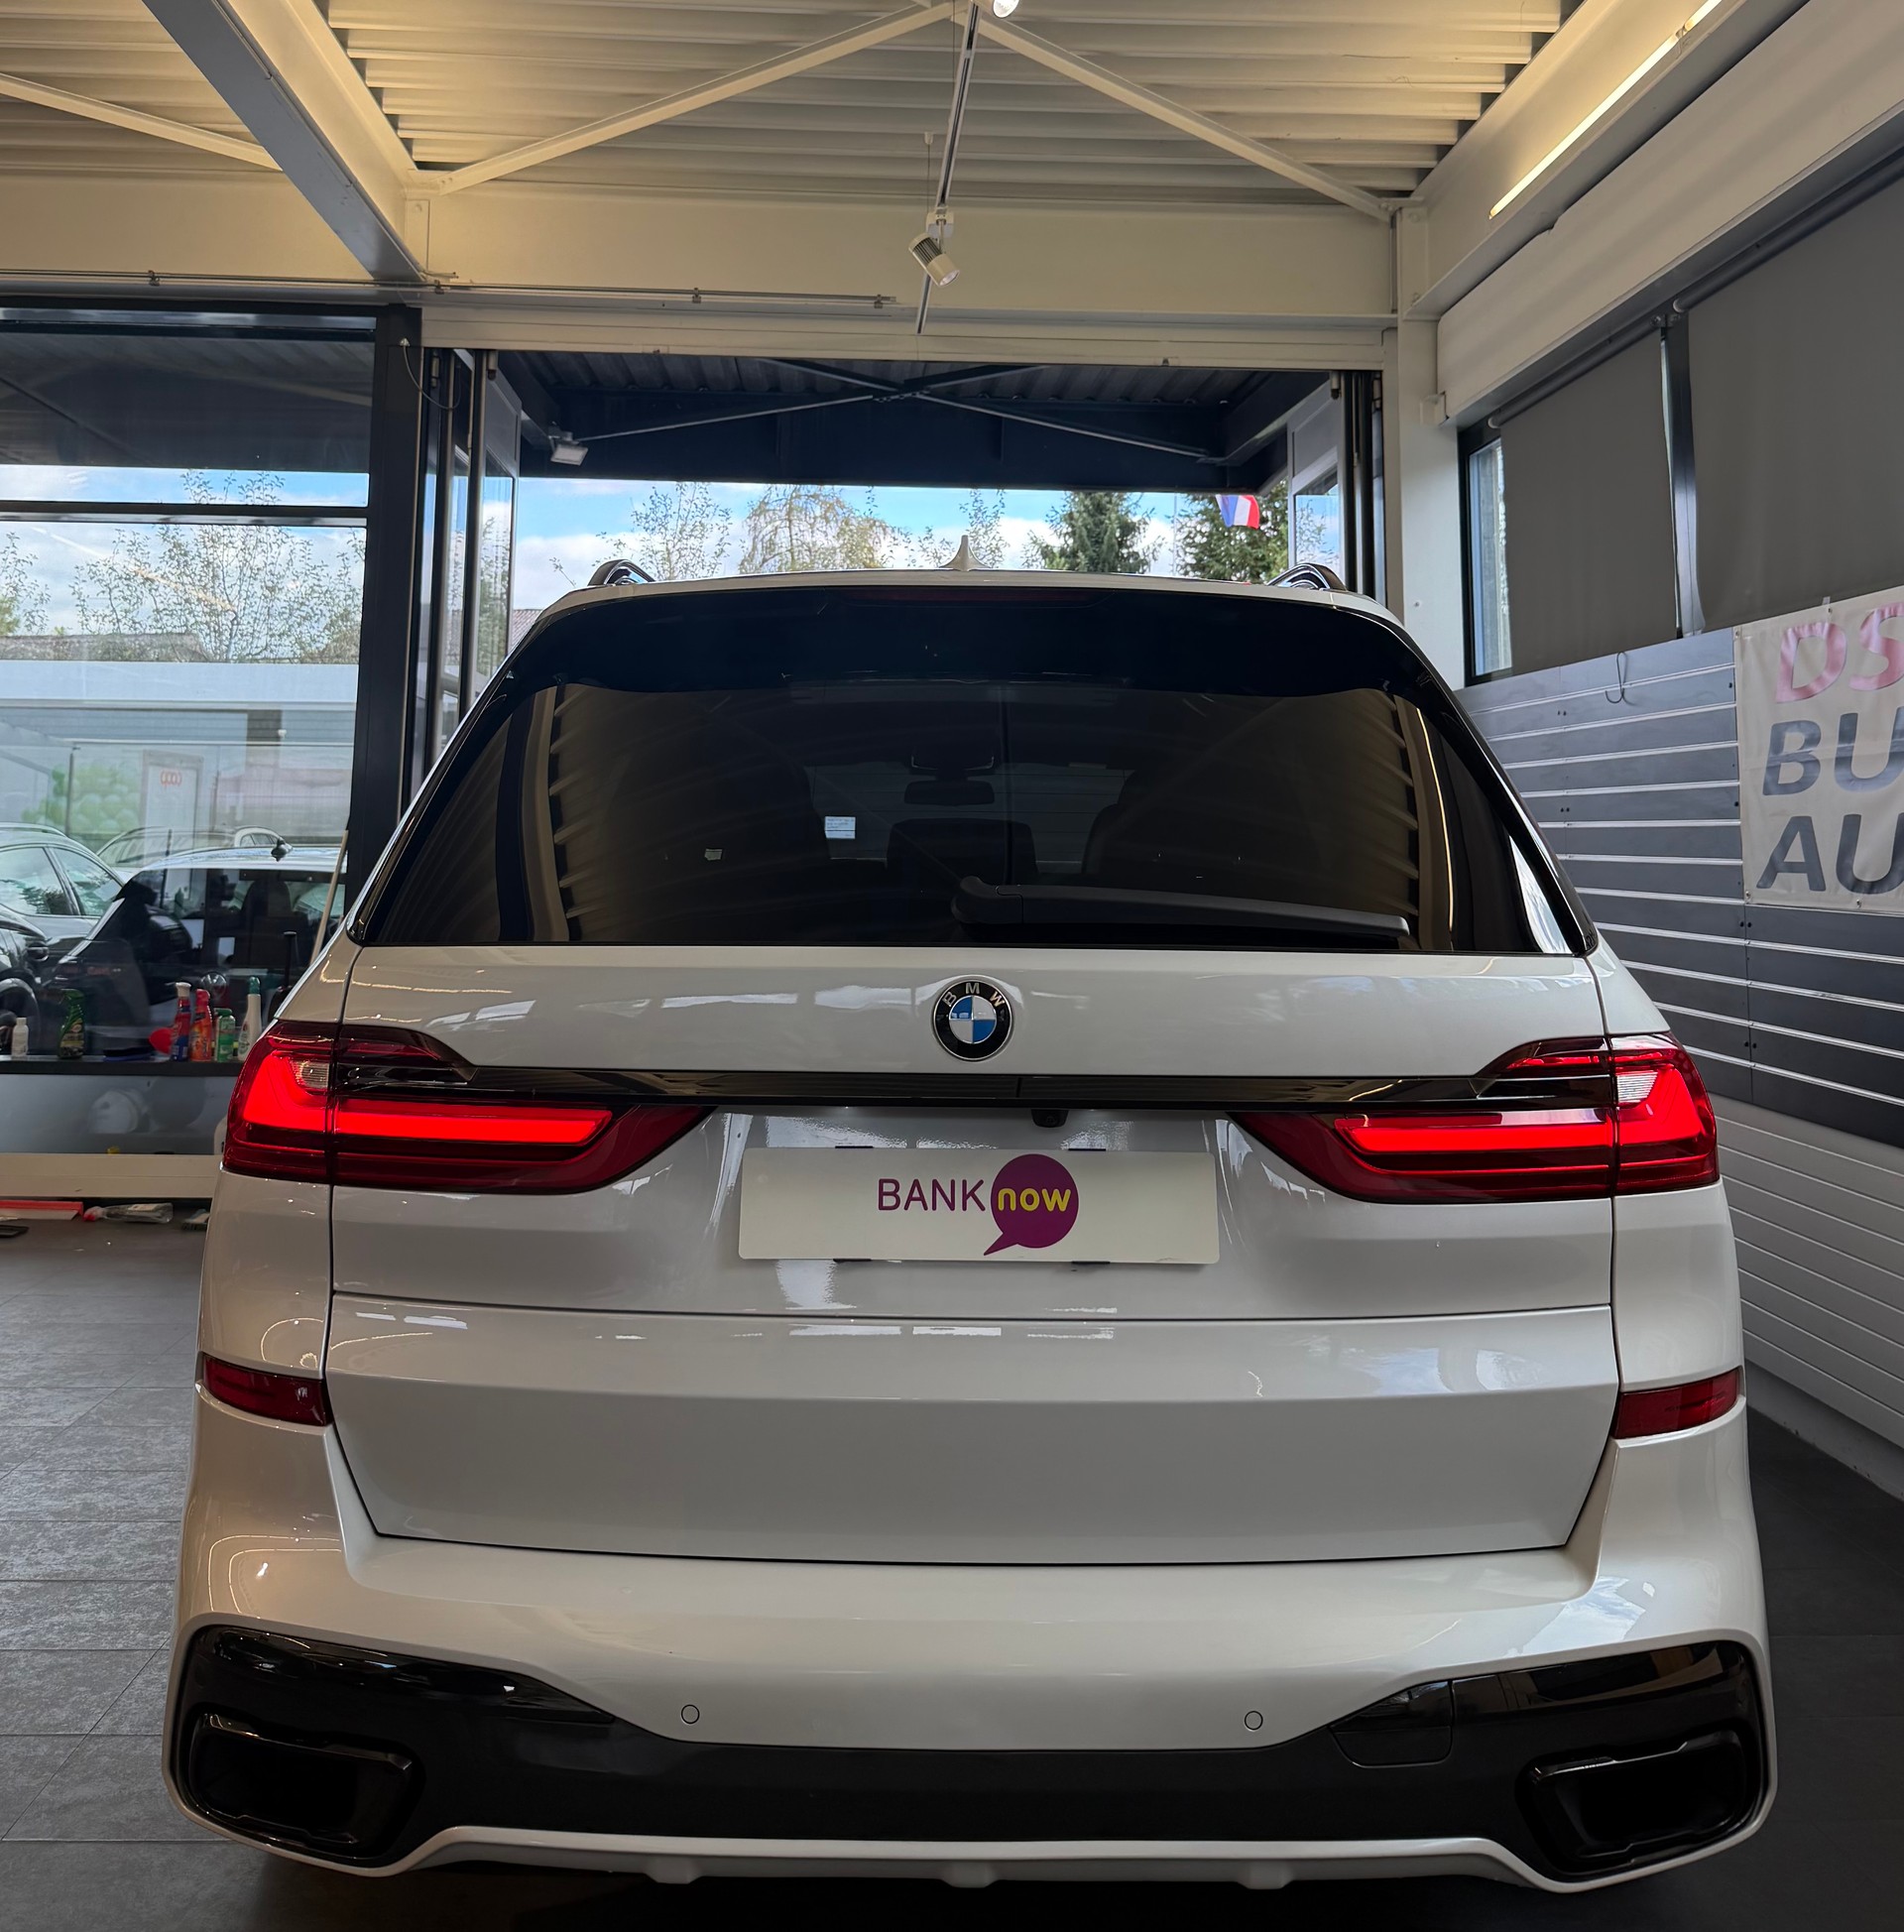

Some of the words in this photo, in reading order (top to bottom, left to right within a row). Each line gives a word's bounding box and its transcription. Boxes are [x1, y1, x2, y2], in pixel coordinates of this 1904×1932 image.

[942, 982, 1006, 1008] BMW
[878, 1178, 986, 1212] BANK
[998, 1187, 1071, 1212] now
